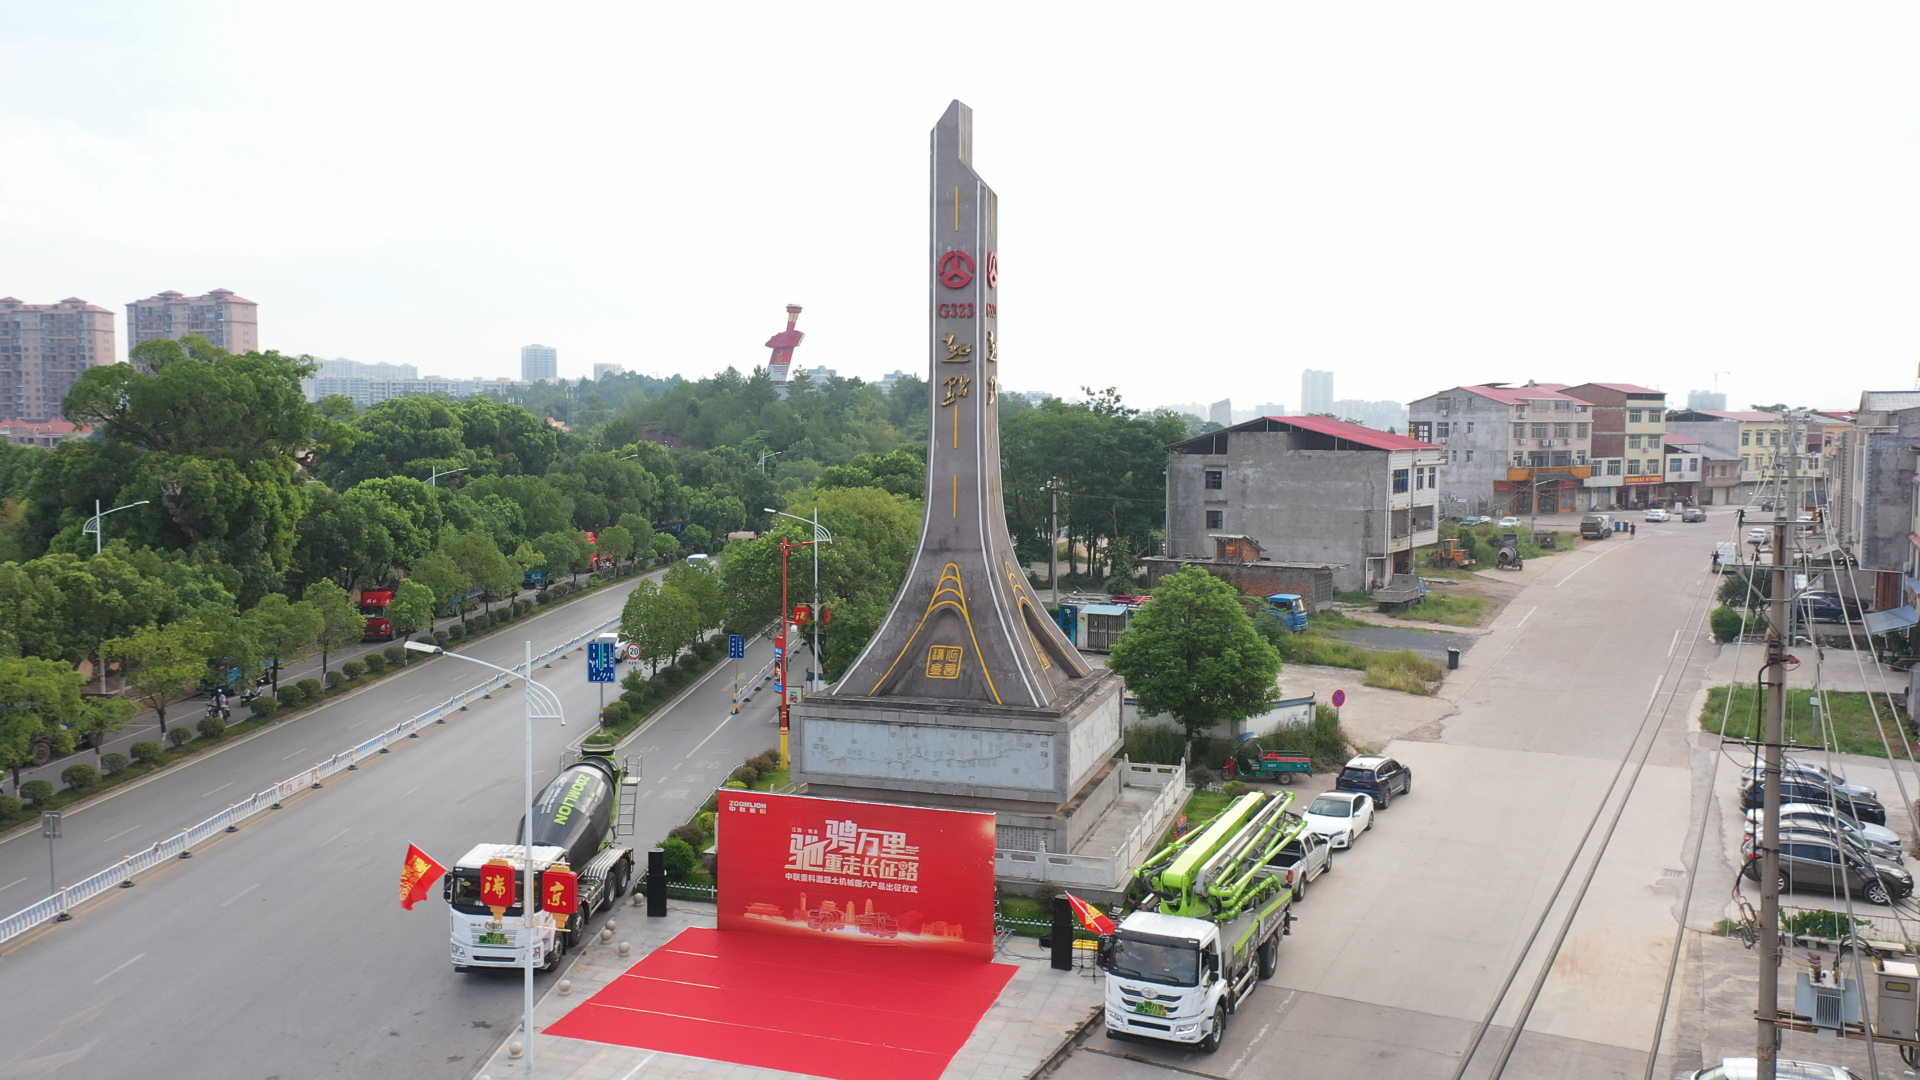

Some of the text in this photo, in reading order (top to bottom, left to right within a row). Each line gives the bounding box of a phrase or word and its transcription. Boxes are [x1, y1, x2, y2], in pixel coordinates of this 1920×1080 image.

[939, 303, 974, 318] G323
[630, 648, 639, 656] 20
[553, 774, 591, 826] ZOOMLION
[729, 800, 767, 809] ZOOMLION
[784, 819, 920, 871] 驰骋万里
[823, 853, 920, 882] 重走长征路
[484, 874, 506, 899] 瑞
[547, 881, 567, 907] 京
[784, 872, 919, 894] 中联重科混凝土机械国六产品出征仪式
